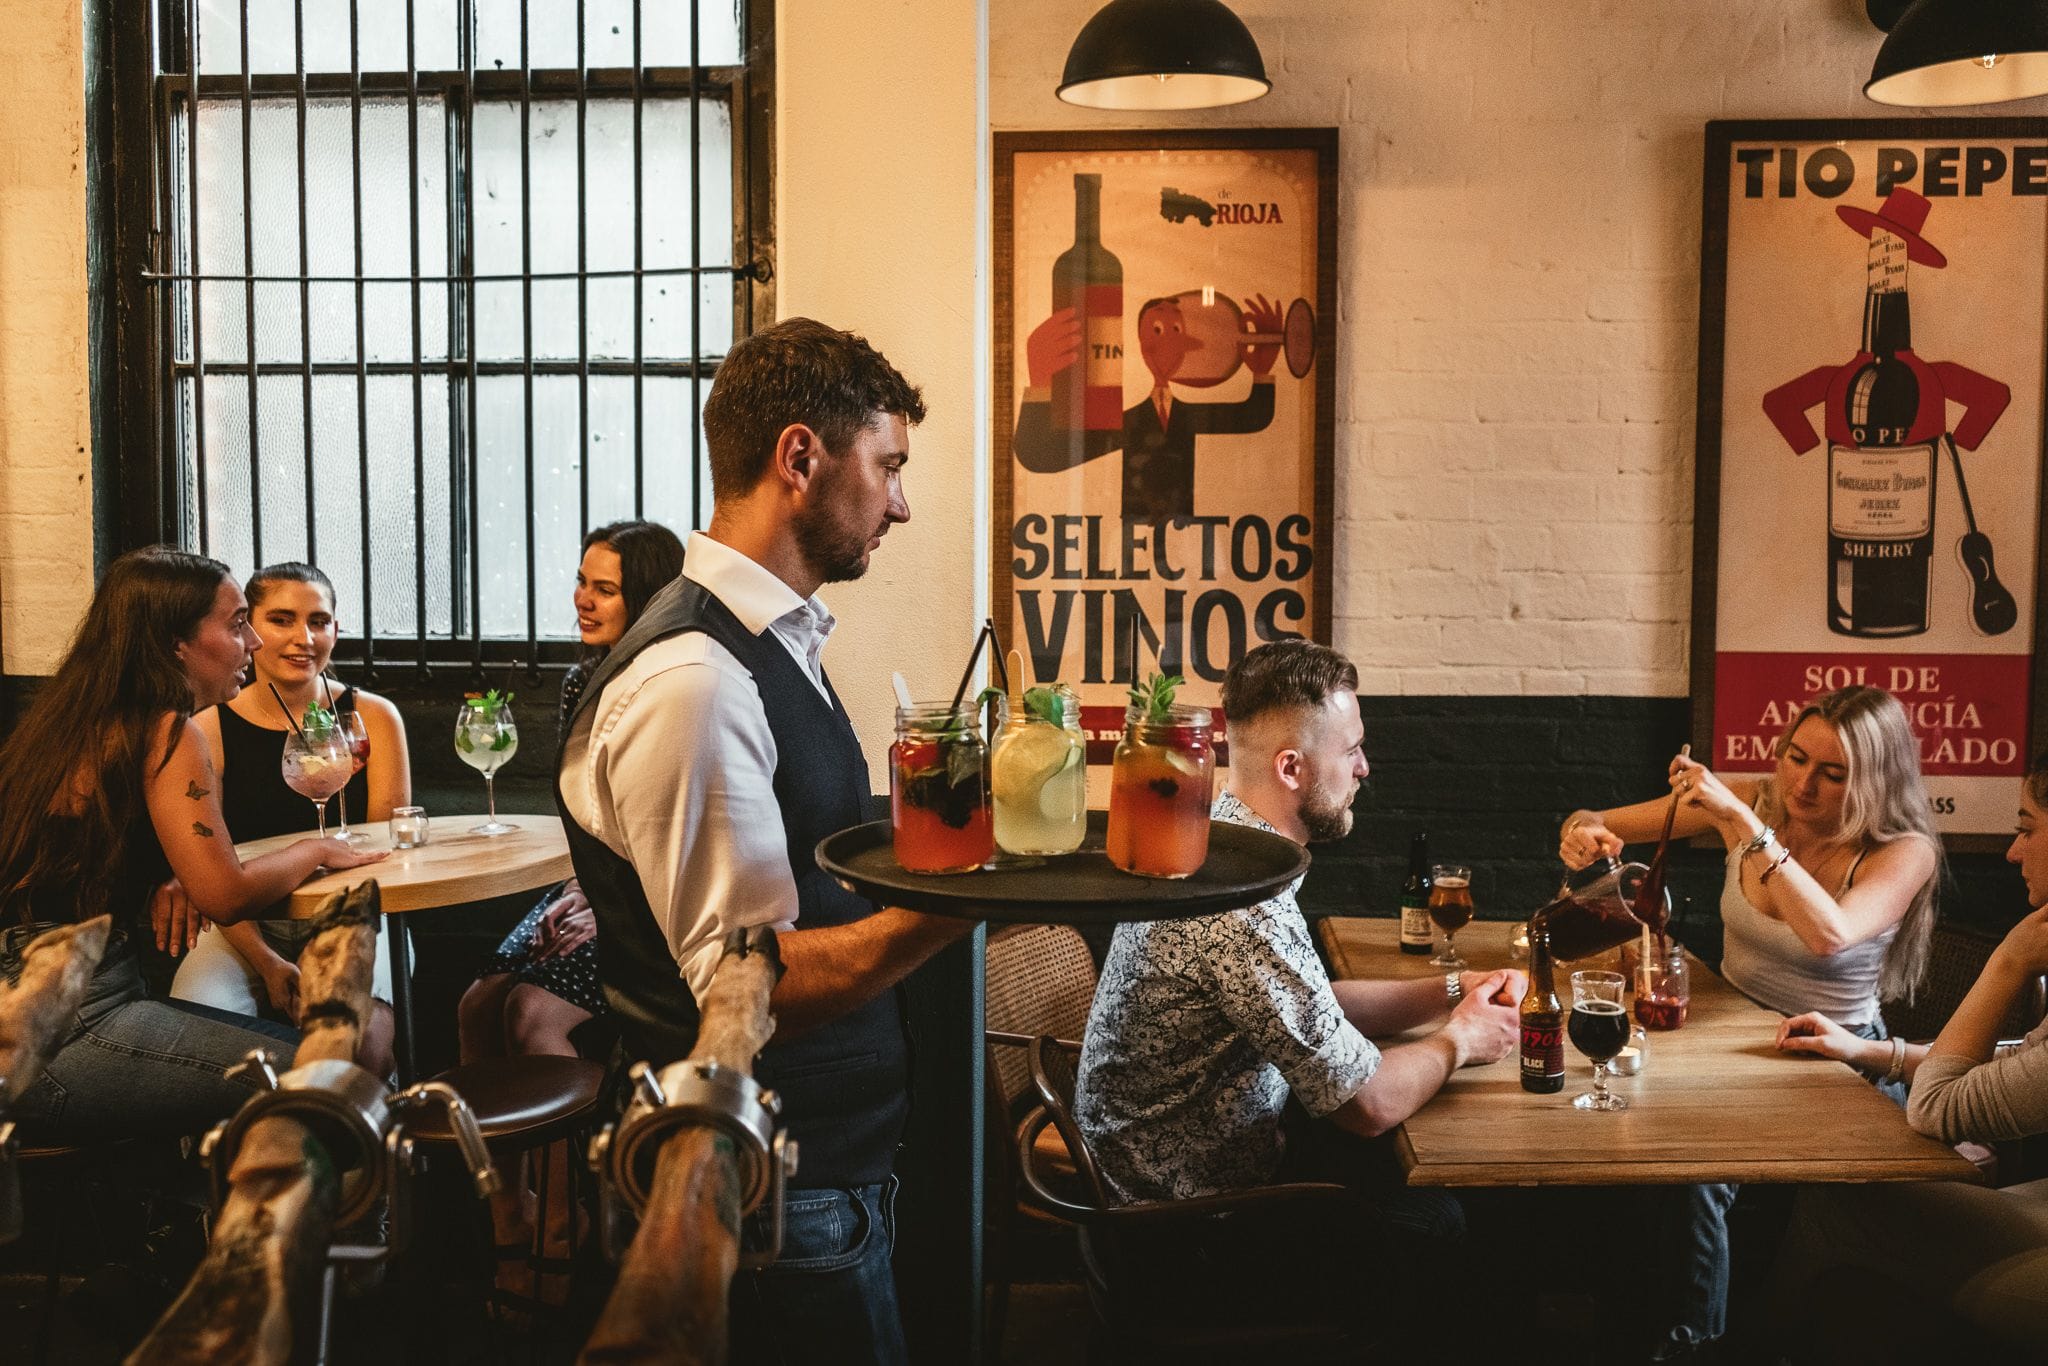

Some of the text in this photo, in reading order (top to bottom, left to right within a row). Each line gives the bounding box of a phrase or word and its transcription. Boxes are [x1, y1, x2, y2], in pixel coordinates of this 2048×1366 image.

[1737, 147, 2048, 198] TIO PEPE
[1216, 203, 1284, 224] RIOJA
[1011, 513, 1314, 582] SELECTOS
[1843, 541, 1914, 558] SHERRY
[1015, 588, 1308, 685] VINOS
[1804, 665, 1940, 693] SOL DE
